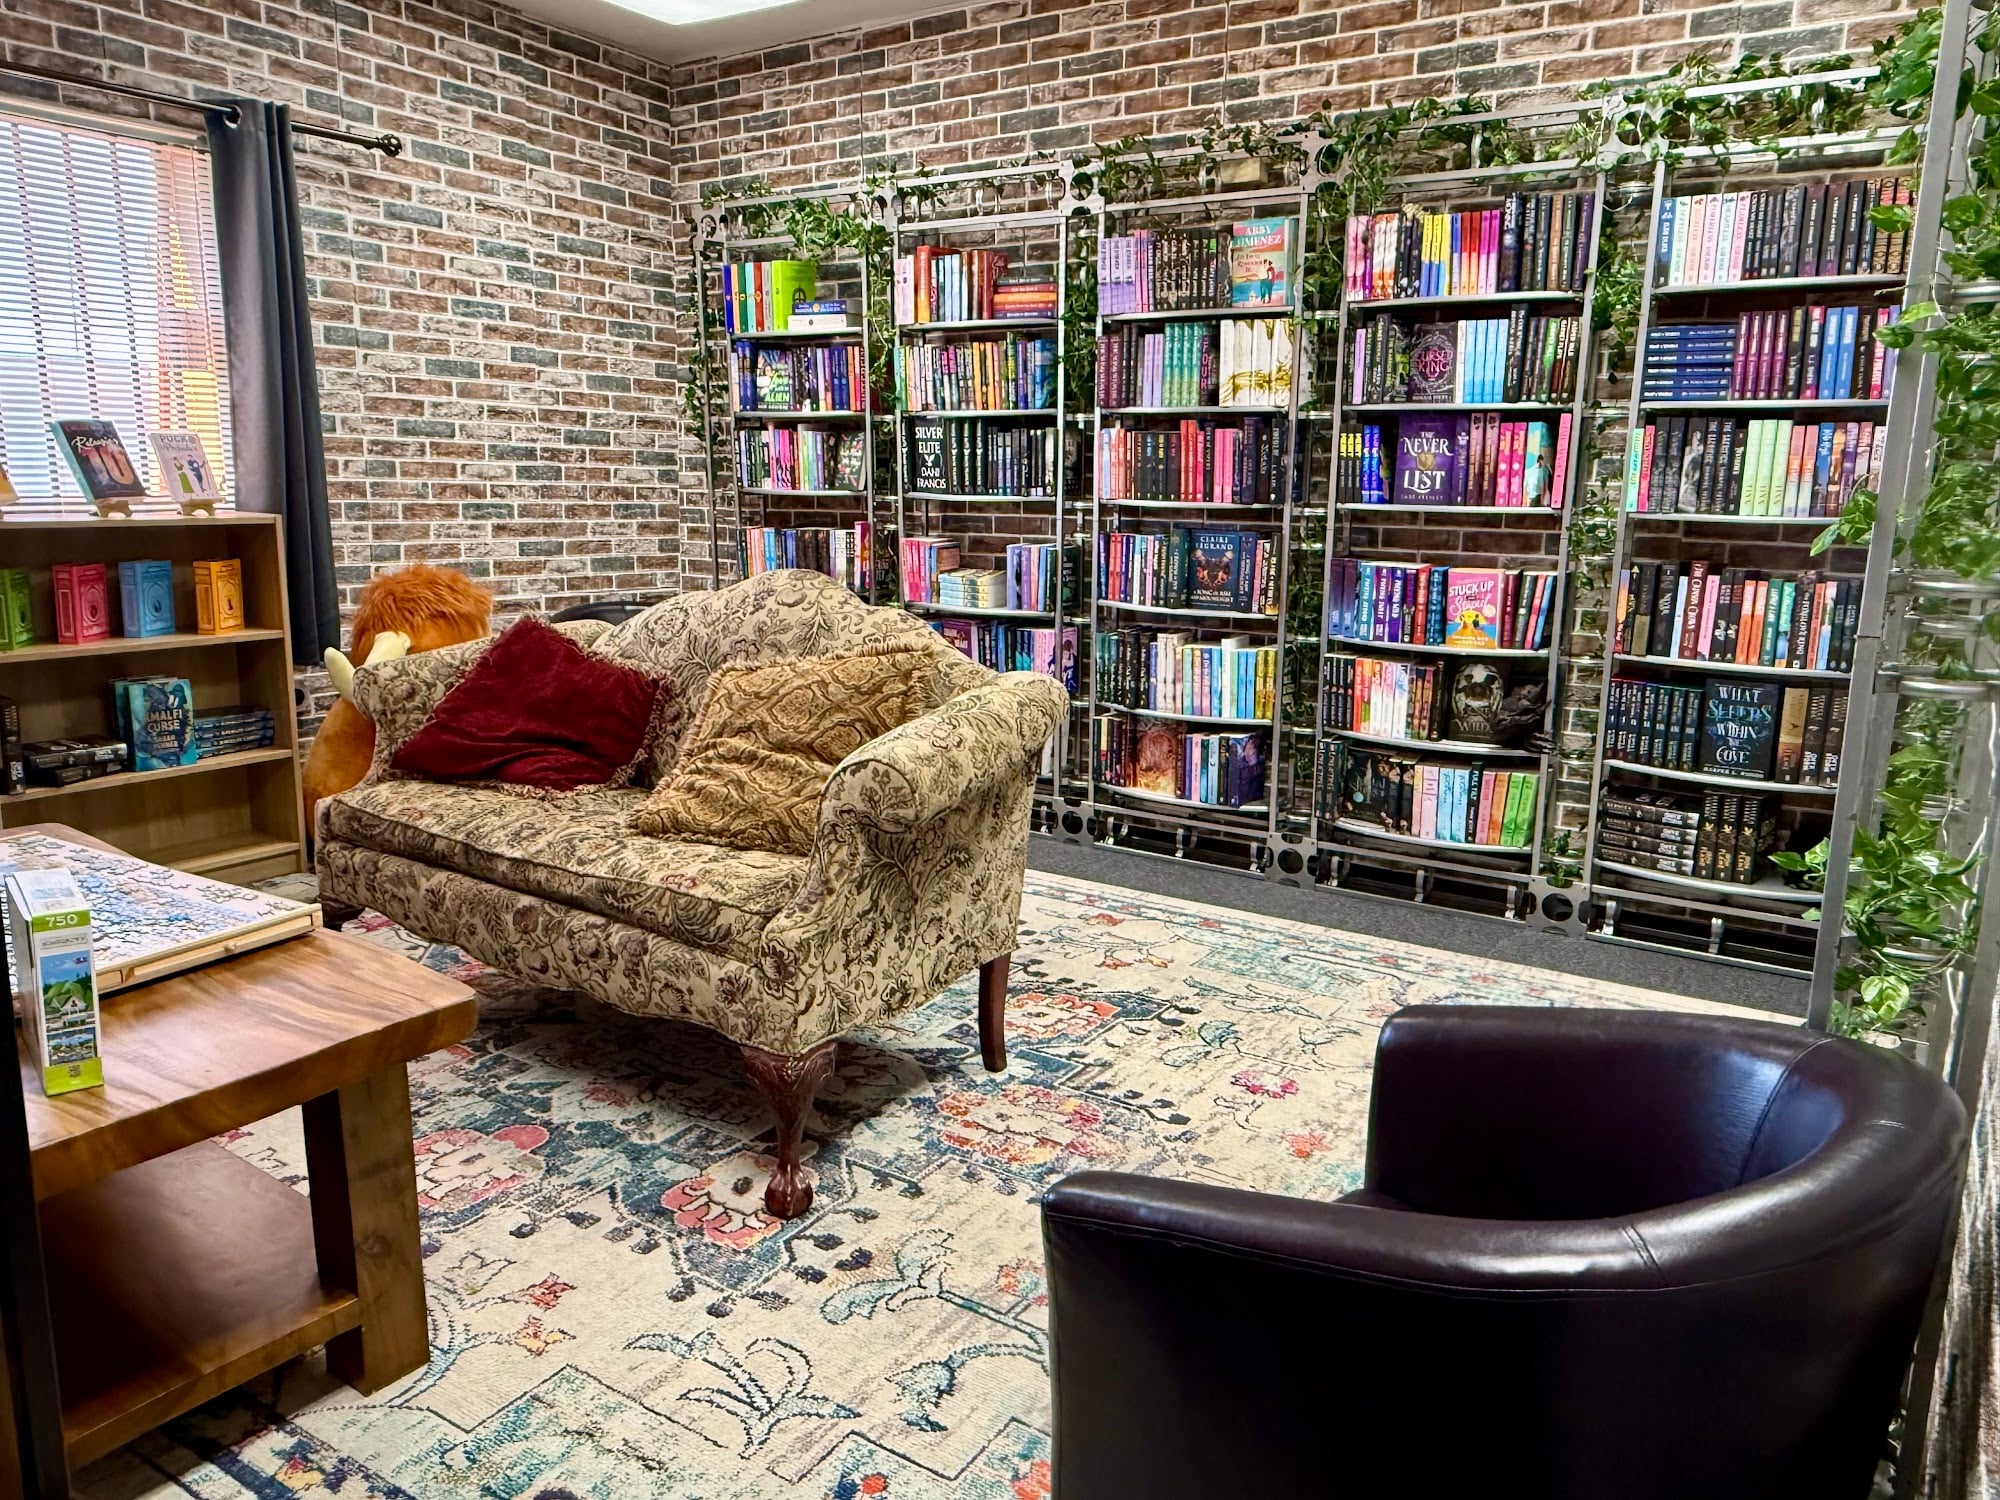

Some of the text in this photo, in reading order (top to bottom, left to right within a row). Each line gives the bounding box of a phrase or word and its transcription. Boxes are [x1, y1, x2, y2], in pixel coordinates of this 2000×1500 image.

[1245, 225, 1271, 235] ABBY
[1236, 235, 1281, 248] JIMENEZ
[915, 427, 943, 439] SILVER
[1708, 421, 1717, 431] THE
[1723, 421, 1732, 431] THE
[1420, 431, 1435, 440] THE
[919, 442, 940, 454] ELITE
[1401, 436, 1453, 457] NEVER
[81, 446, 134, 485] 10
[921, 467, 940, 476] DANI
[917, 478, 946, 488] FRANCIS
[1404, 470, 1445, 493] LIST
[1449, 580, 1495, 597] STUCK UP
[1449, 593, 1490, 616] Stupid
[1798, 601, 1810, 636] FOXGLOVE
[1796, 636, 1807, 655] KING
[1718, 686, 1761, 702] WHAT
[1707, 699, 1772, 723] SLEEPS
[148, 719, 180, 731] CURSE
[1716, 722, 1759, 739] WITHIN
[1716, 745, 1750, 765] COVE
[1803, 751, 1811, 771] STORM
[1809, 753, 1817, 770] ONYX
[1824, 753, 1832, 773] STORM
[1830, 755, 1838, 771] ONYX
[1471, 771, 1479, 786] FULL
